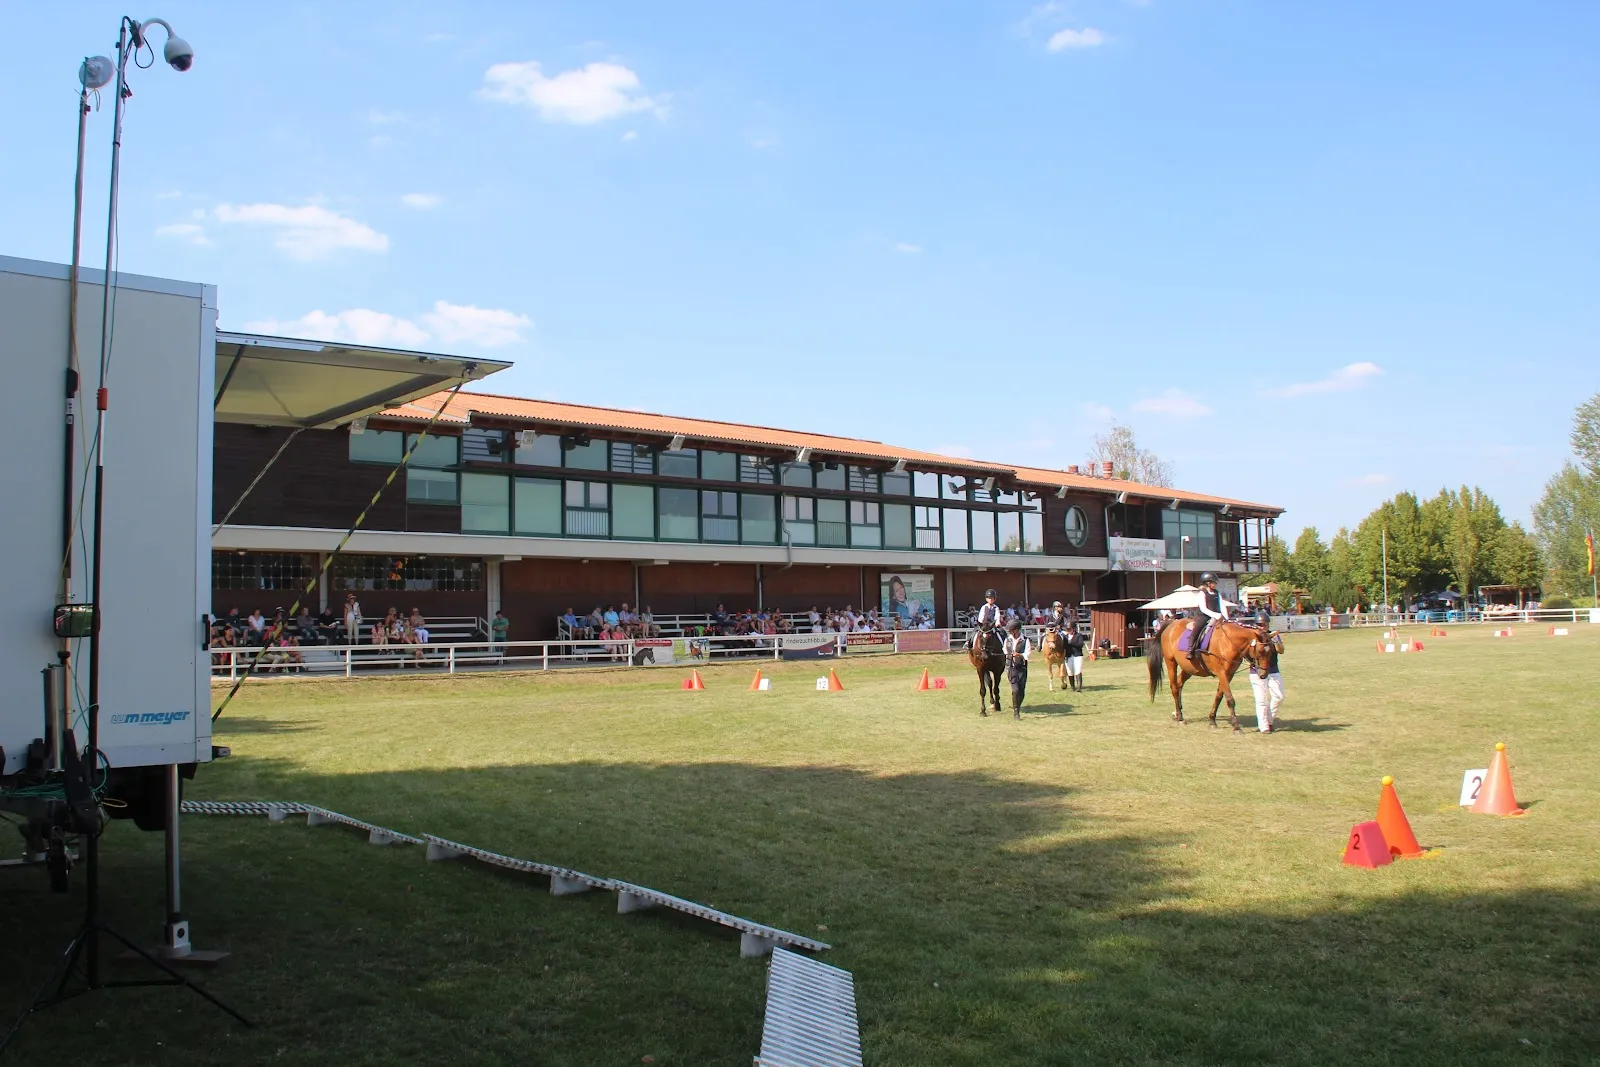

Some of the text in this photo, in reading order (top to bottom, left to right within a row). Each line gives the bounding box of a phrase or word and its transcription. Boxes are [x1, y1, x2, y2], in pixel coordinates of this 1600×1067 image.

[818, 680, 827, 689] 12
[935, 680, 944, 689] 12
[140, 711, 191, 725] meyer
[1470, 776, 1483, 800] 2
[1353, 833, 1361, 850] 2
